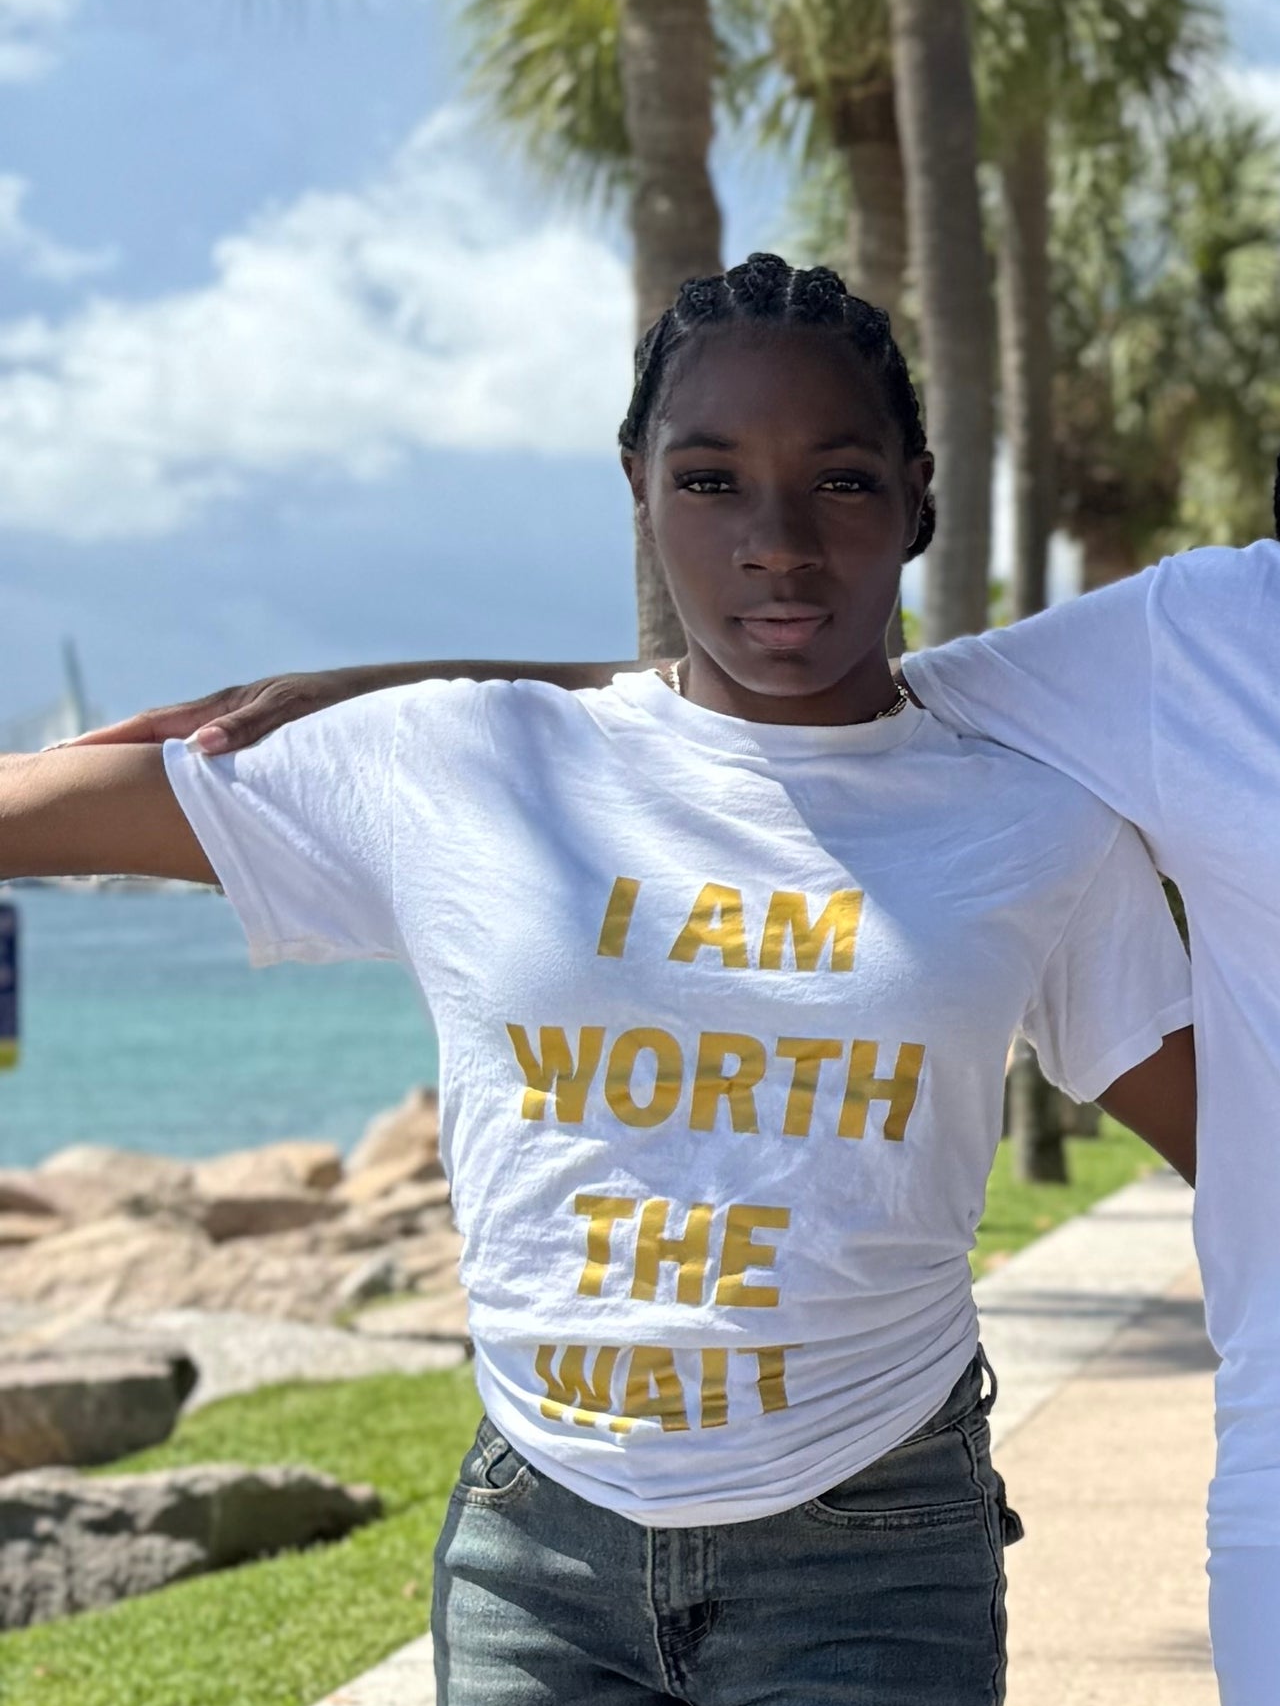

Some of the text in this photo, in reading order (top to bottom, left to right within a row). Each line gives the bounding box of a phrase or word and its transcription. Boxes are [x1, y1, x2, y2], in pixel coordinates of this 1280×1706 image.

[597, 877, 864, 972] I AM
[505, 1023, 926, 1142] WORTH
[574, 1194, 791, 1308] THE
[535, 1344, 803, 1433] WAIT
